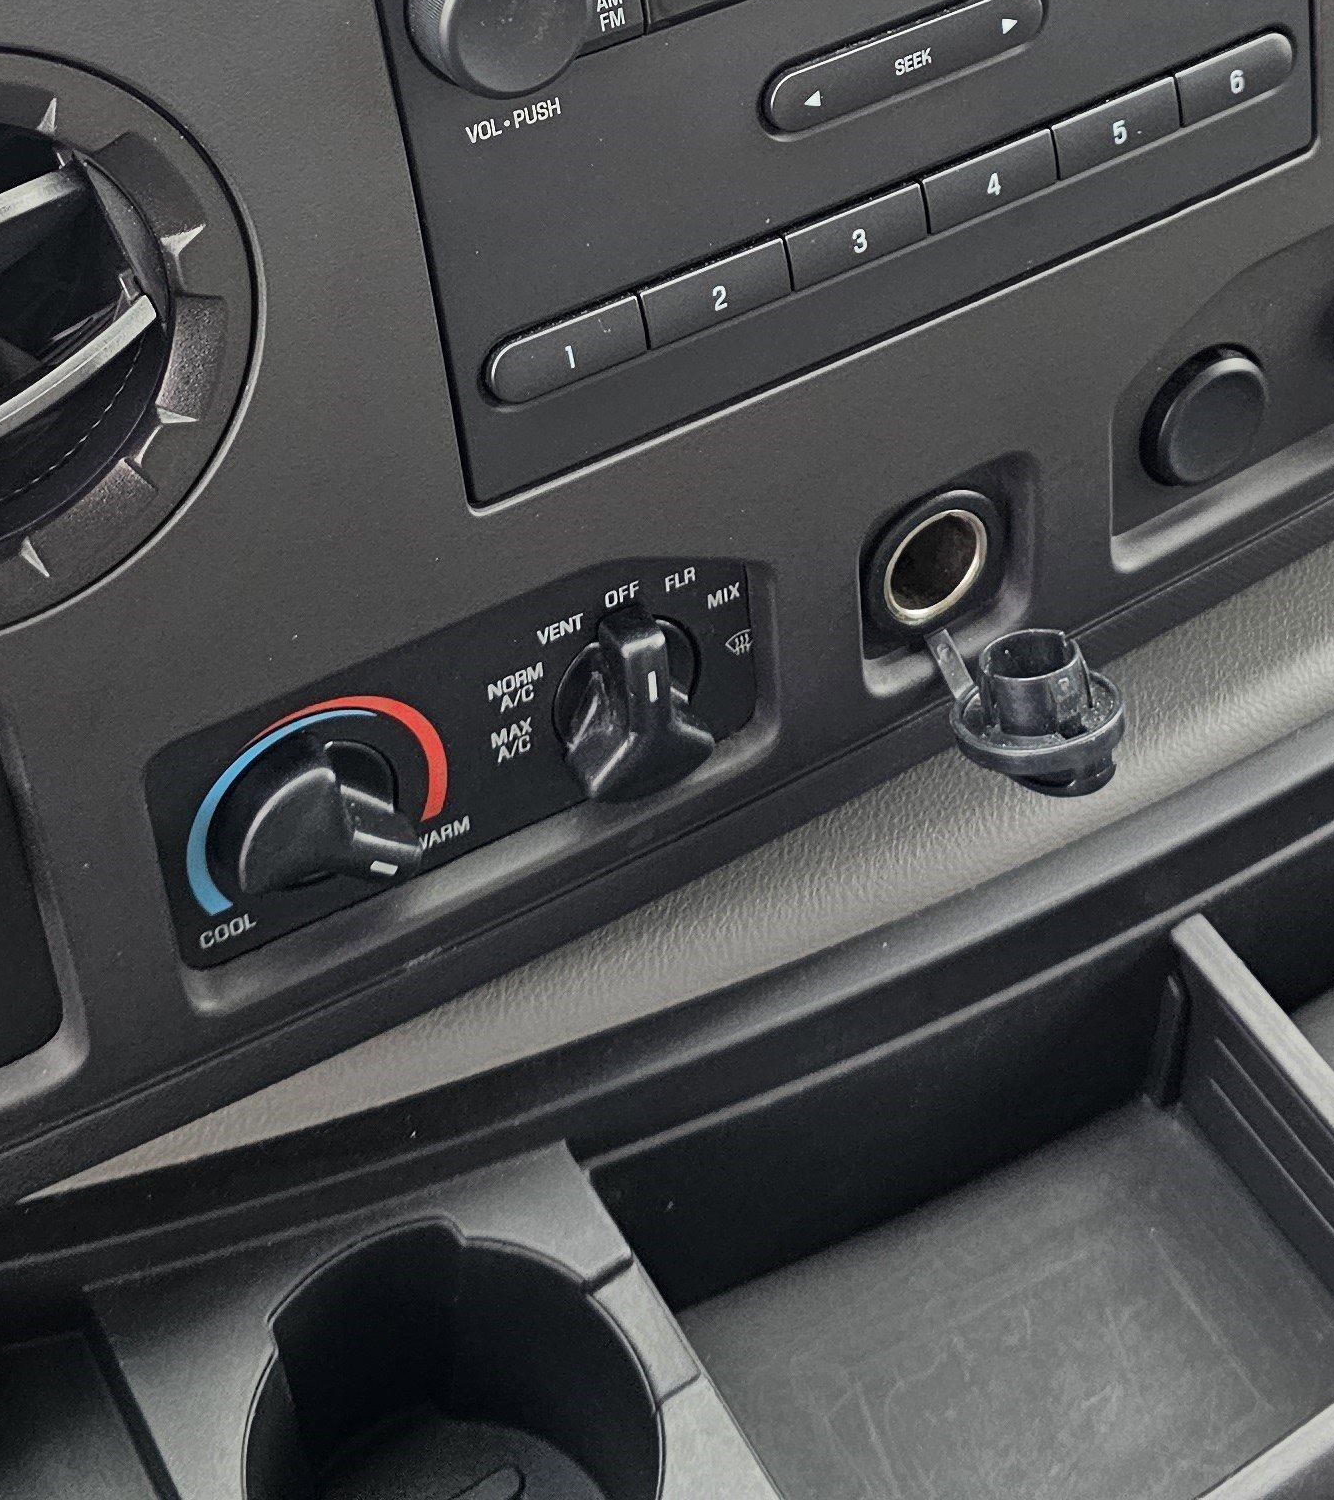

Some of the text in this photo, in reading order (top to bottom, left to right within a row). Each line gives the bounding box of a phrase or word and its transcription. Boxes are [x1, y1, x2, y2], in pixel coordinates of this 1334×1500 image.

[599, 7, 626, 32] FM
[894, 47, 932, 76] SEEK
[1229, 69, 1245, 95] 6
[1112, 119, 1128, 145] 5
[985, 171, 1002, 197] 4
[851, 228, 868, 254] 3
[712, 285, 729, 312] 2
[563, 345, 576, 369] 1
[664, 566, 696, 593] FLR
[604, 580, 640, 608] OFF
[707, 582, 740, 610] MIX
[536, 613, 584, 645] VENT
[487, 661, 544, 701] NORM
[500, 684, 535, 713] A/C
[490, 716, 533, 749] MAX
[497, 735, 532, 764] A/C
[199, 912, 257, 949] COOL
